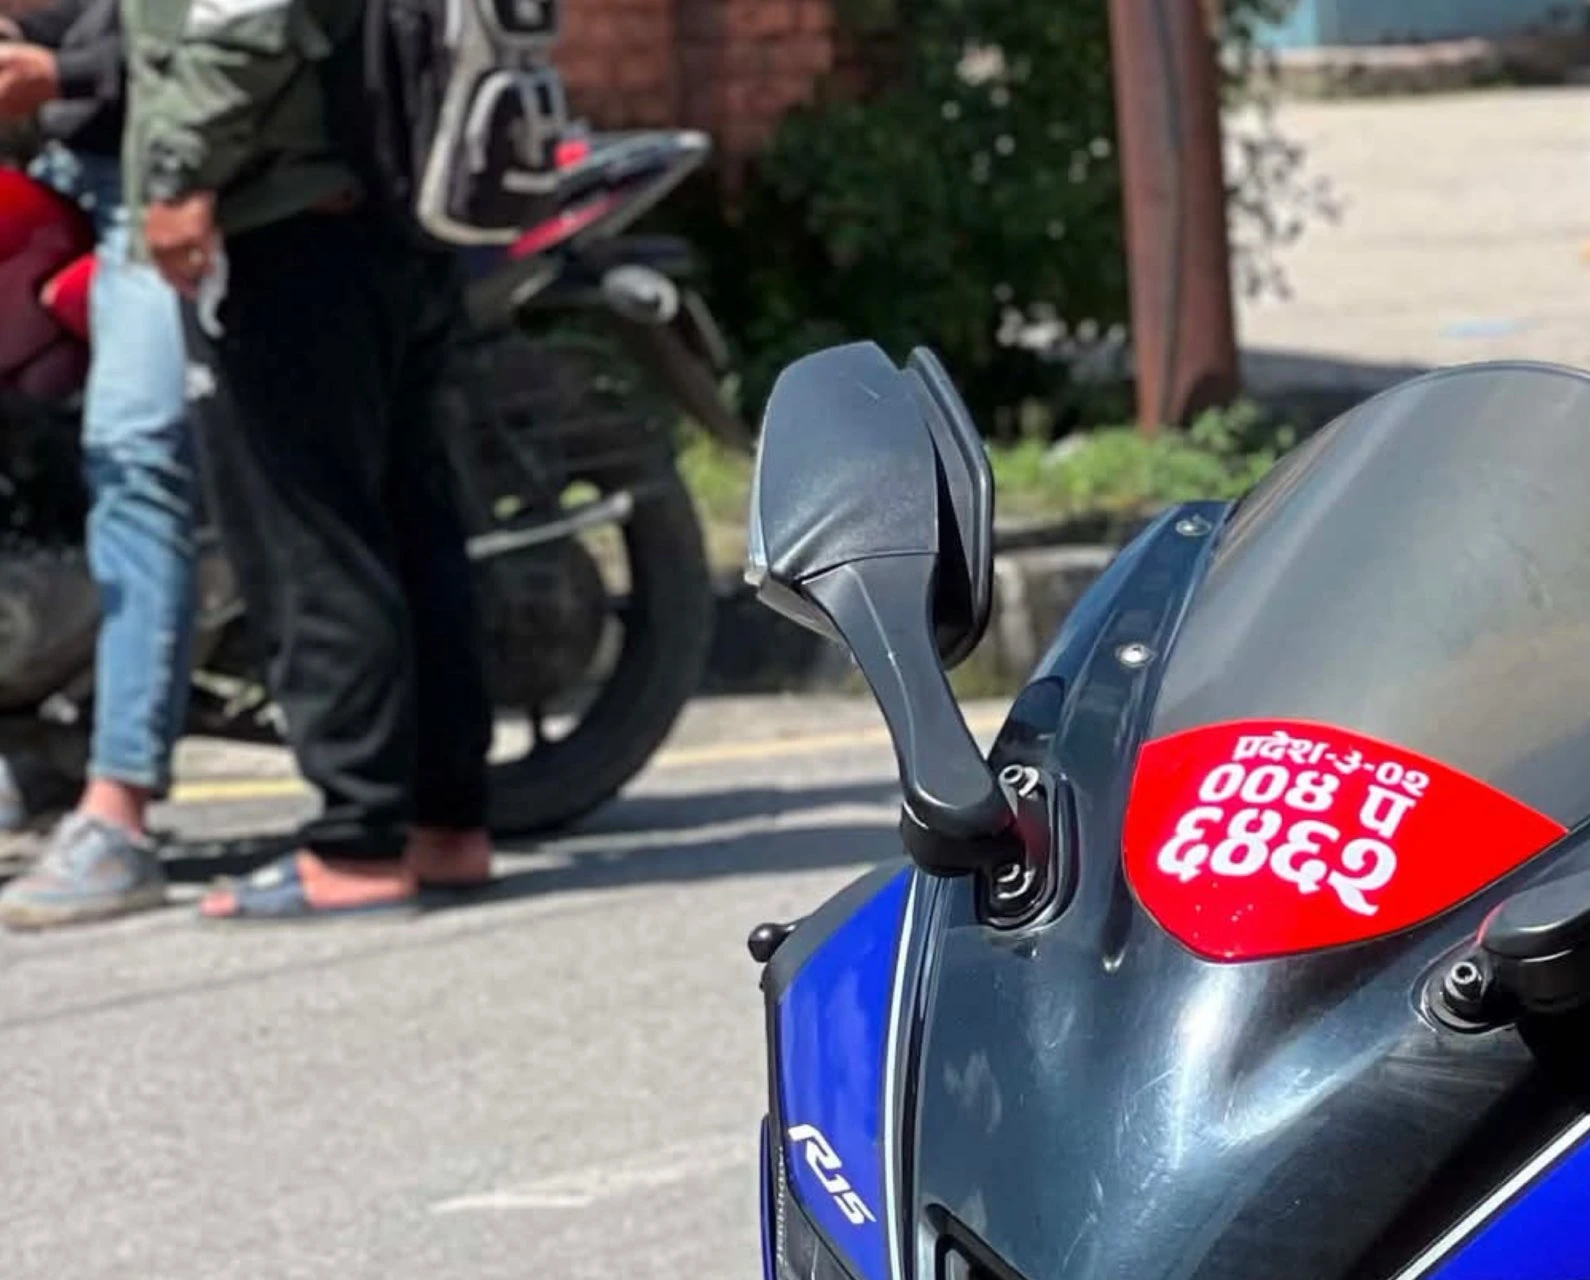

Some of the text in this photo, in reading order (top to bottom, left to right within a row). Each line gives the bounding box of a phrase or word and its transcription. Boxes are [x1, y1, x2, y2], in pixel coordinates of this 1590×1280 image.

[1198, 762, 1417, 840] ००४ प
[1156, 805, 1398, 917] ६४६२
[787, 1123, 877, 1224] R15
